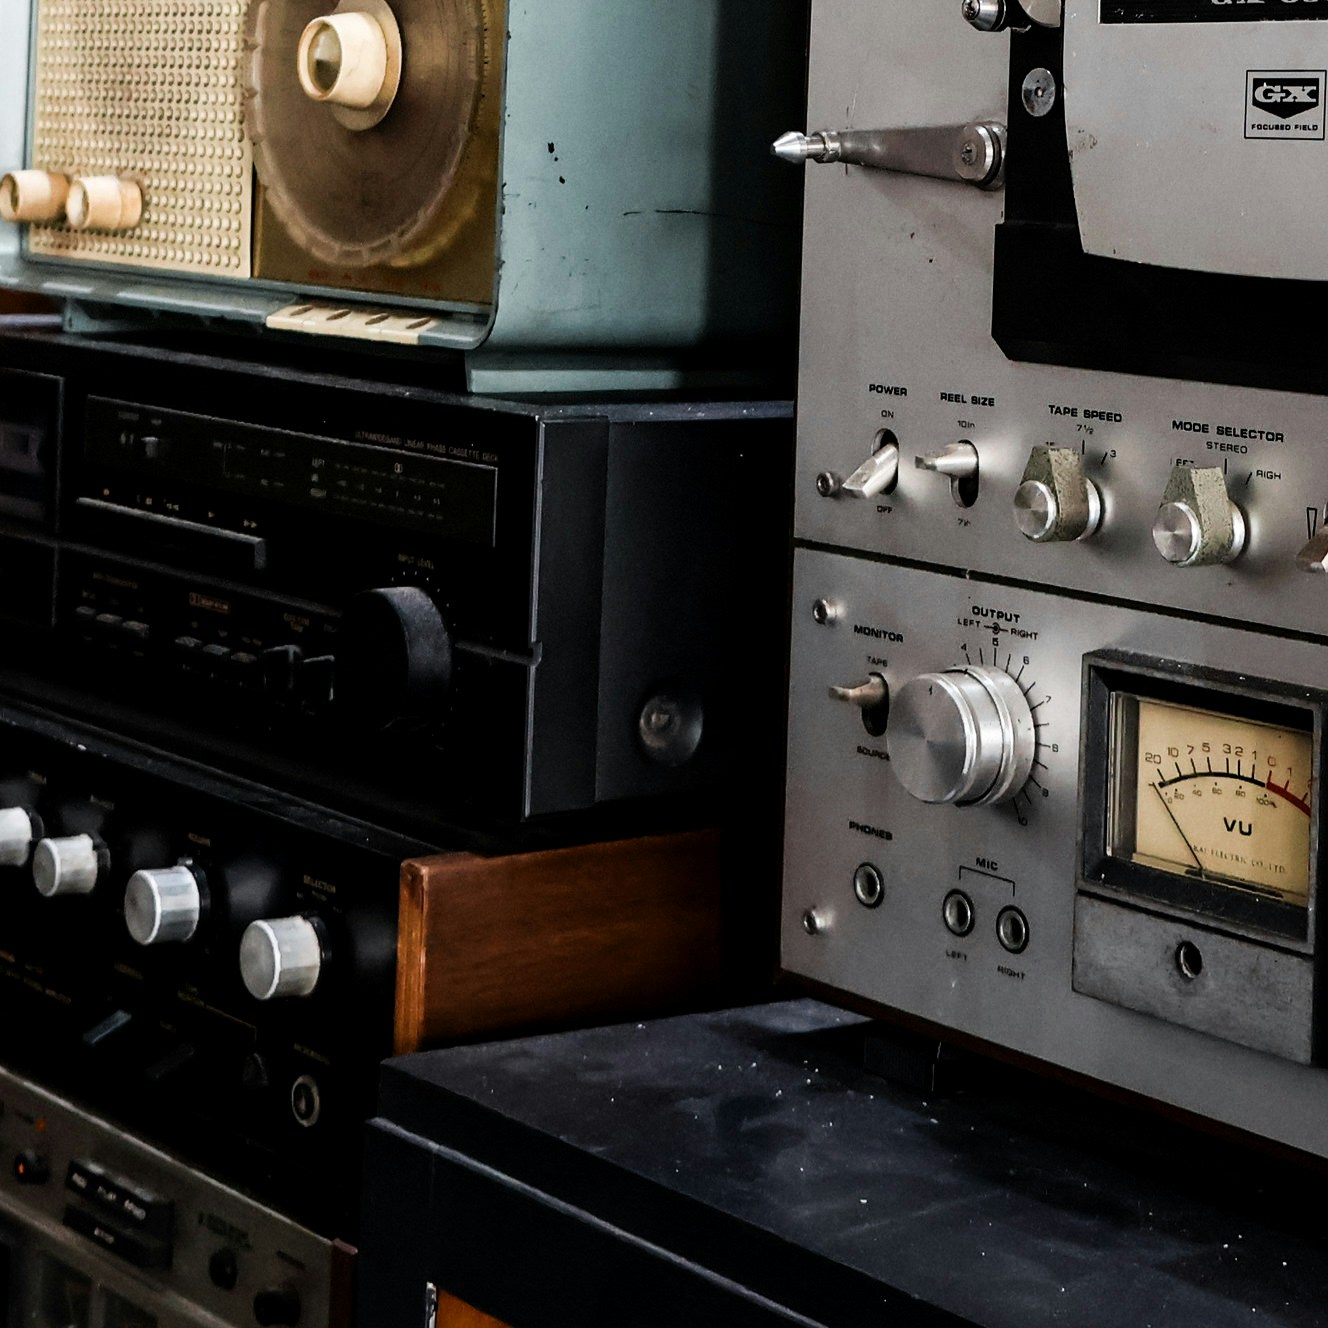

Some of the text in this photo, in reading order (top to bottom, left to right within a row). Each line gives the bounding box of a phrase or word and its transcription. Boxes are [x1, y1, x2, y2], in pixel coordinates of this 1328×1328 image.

[1254, 84, 1317, 103] GX
[1251, 123, 1319, 132] FOCUSED FIELD
[869, 383, 908, 397] POWER
[940, 392, 995, 407] REEL SIZE
[881, 409, 895, 419] ON
[1048, 405, 1122, 423] TAPE SPEED
[1172, 420, 1284, 443] MODE SELECTOR
[1206, 441, 1248, 454] STEREO
[877, 505, 893, 514] OFF
[972, 605, 1021, 624] OUTPUT
[853, 624, 904, 644] MONITOR
[957, 618, 1039, 641] LEFT RIGHT
[867, 655, 888, 668] TAPE
[961, 643, 967, 652] 4
[992, 637, 999, 647] 5
[1022, 655, 1030, 666] 6
[1045, 695, 1052, 705] 7
[1144, 752, 1162, 765] 20
[1167, 747, 1179, 758] 10
[1187, 744, 1195, 755] 7
[1202, 742, 1211, 753] 5
[1222, 743, 1232, 754] 3
[1234, 746, 1244, 757] 2
[1251, 750, 1257, 761] 1
[1267, 755, 1277, 768] 0
[848, 820, 893, 842] PHONES
[1223, 816, 1252, 836] VU
[975, 856, 999, 871] MIC
[946, 950, 968, 962] LEFT
[996, 965, 1026, 981] RIGHT
